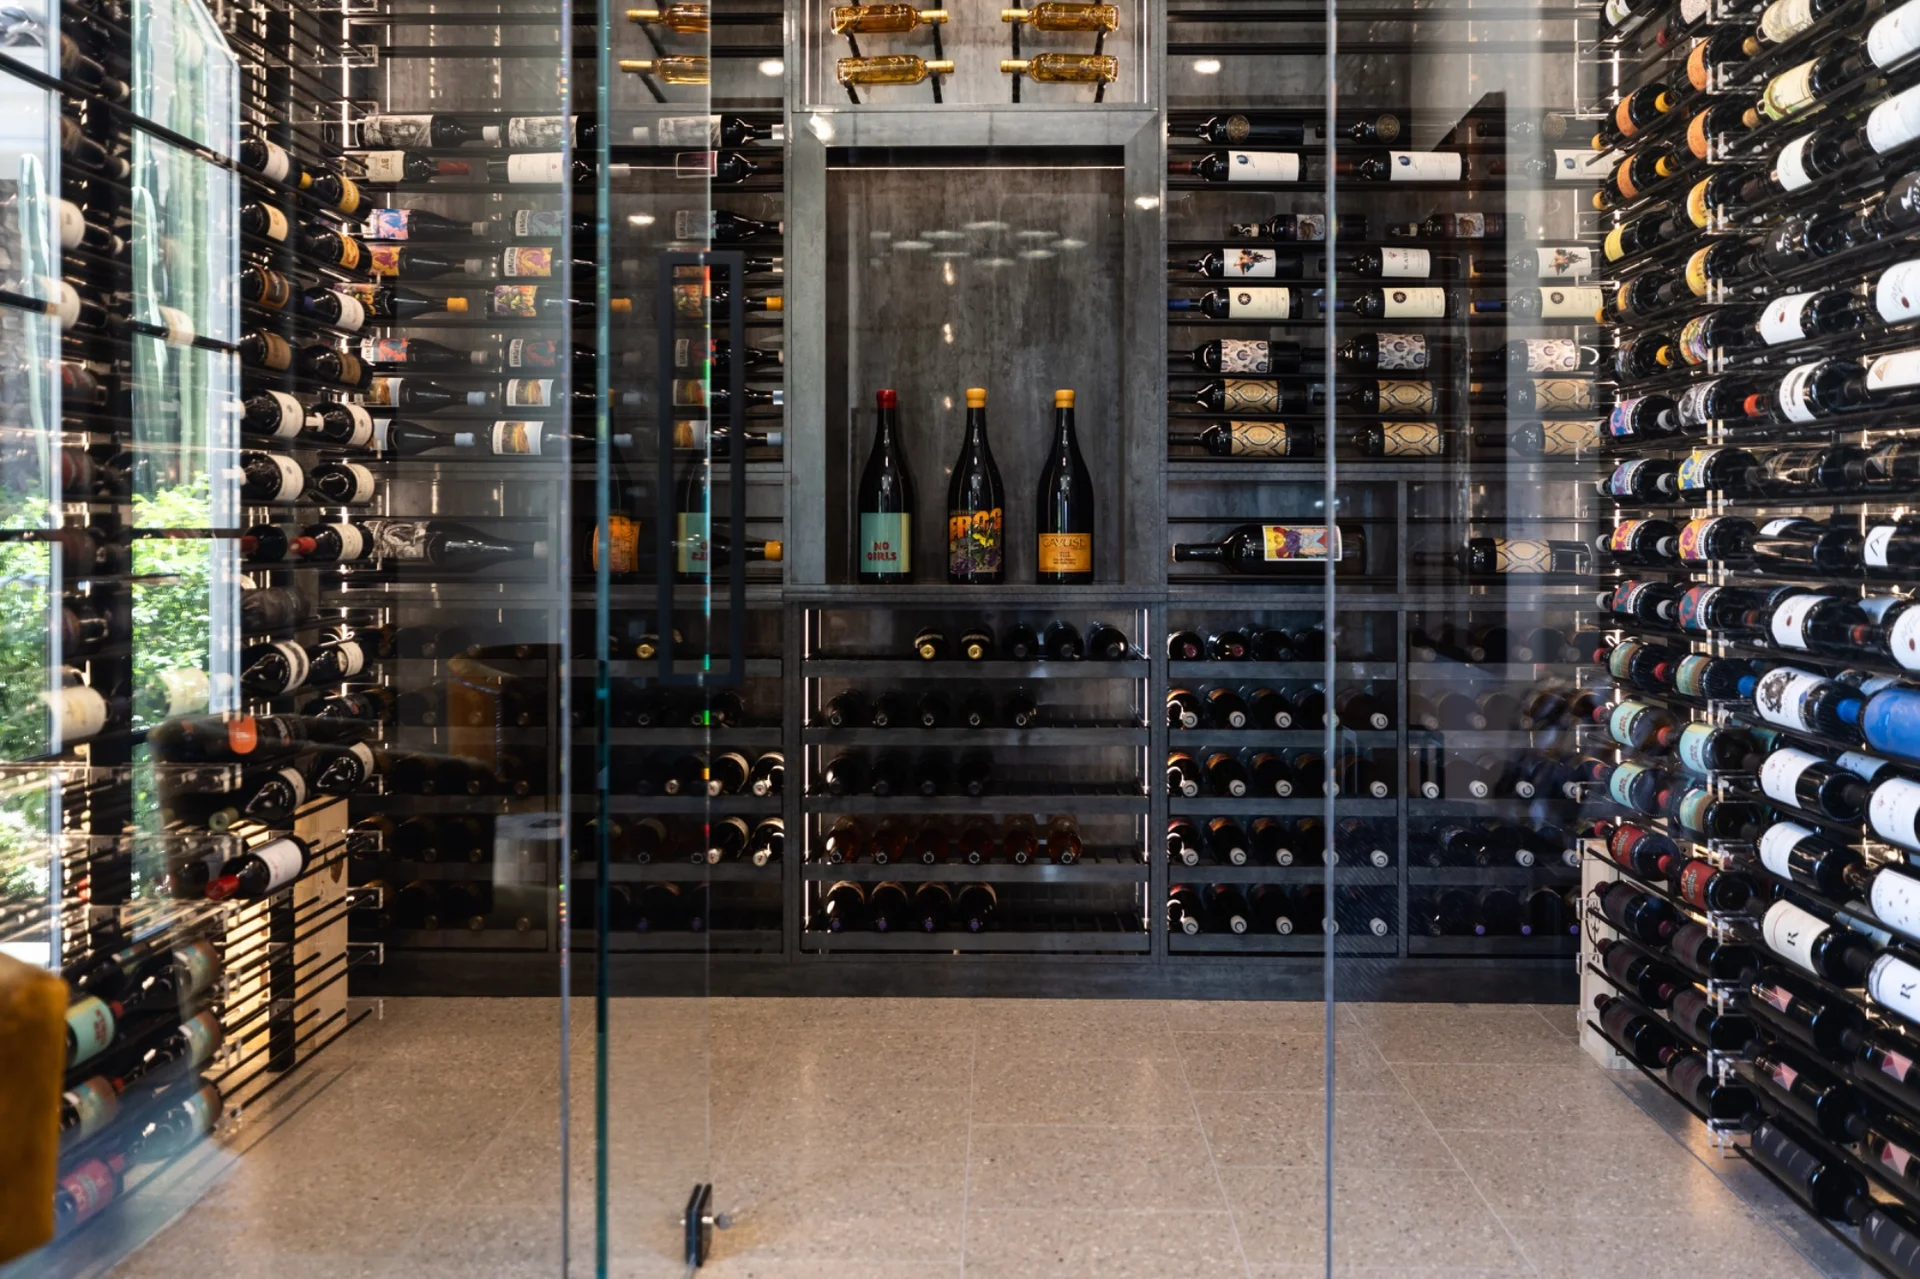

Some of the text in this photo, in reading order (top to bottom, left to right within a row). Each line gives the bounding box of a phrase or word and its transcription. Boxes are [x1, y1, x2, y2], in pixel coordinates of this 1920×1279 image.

[381, 158, 389, 170] BV
[873, 541, 890, 551] NO
[1043, 537, 1085, 547] CAYUSE
[866, 551, 898, 561] GIRLS
[1786, 932, 1799, 946] R
[1900, 984, 1917, 1000] R
